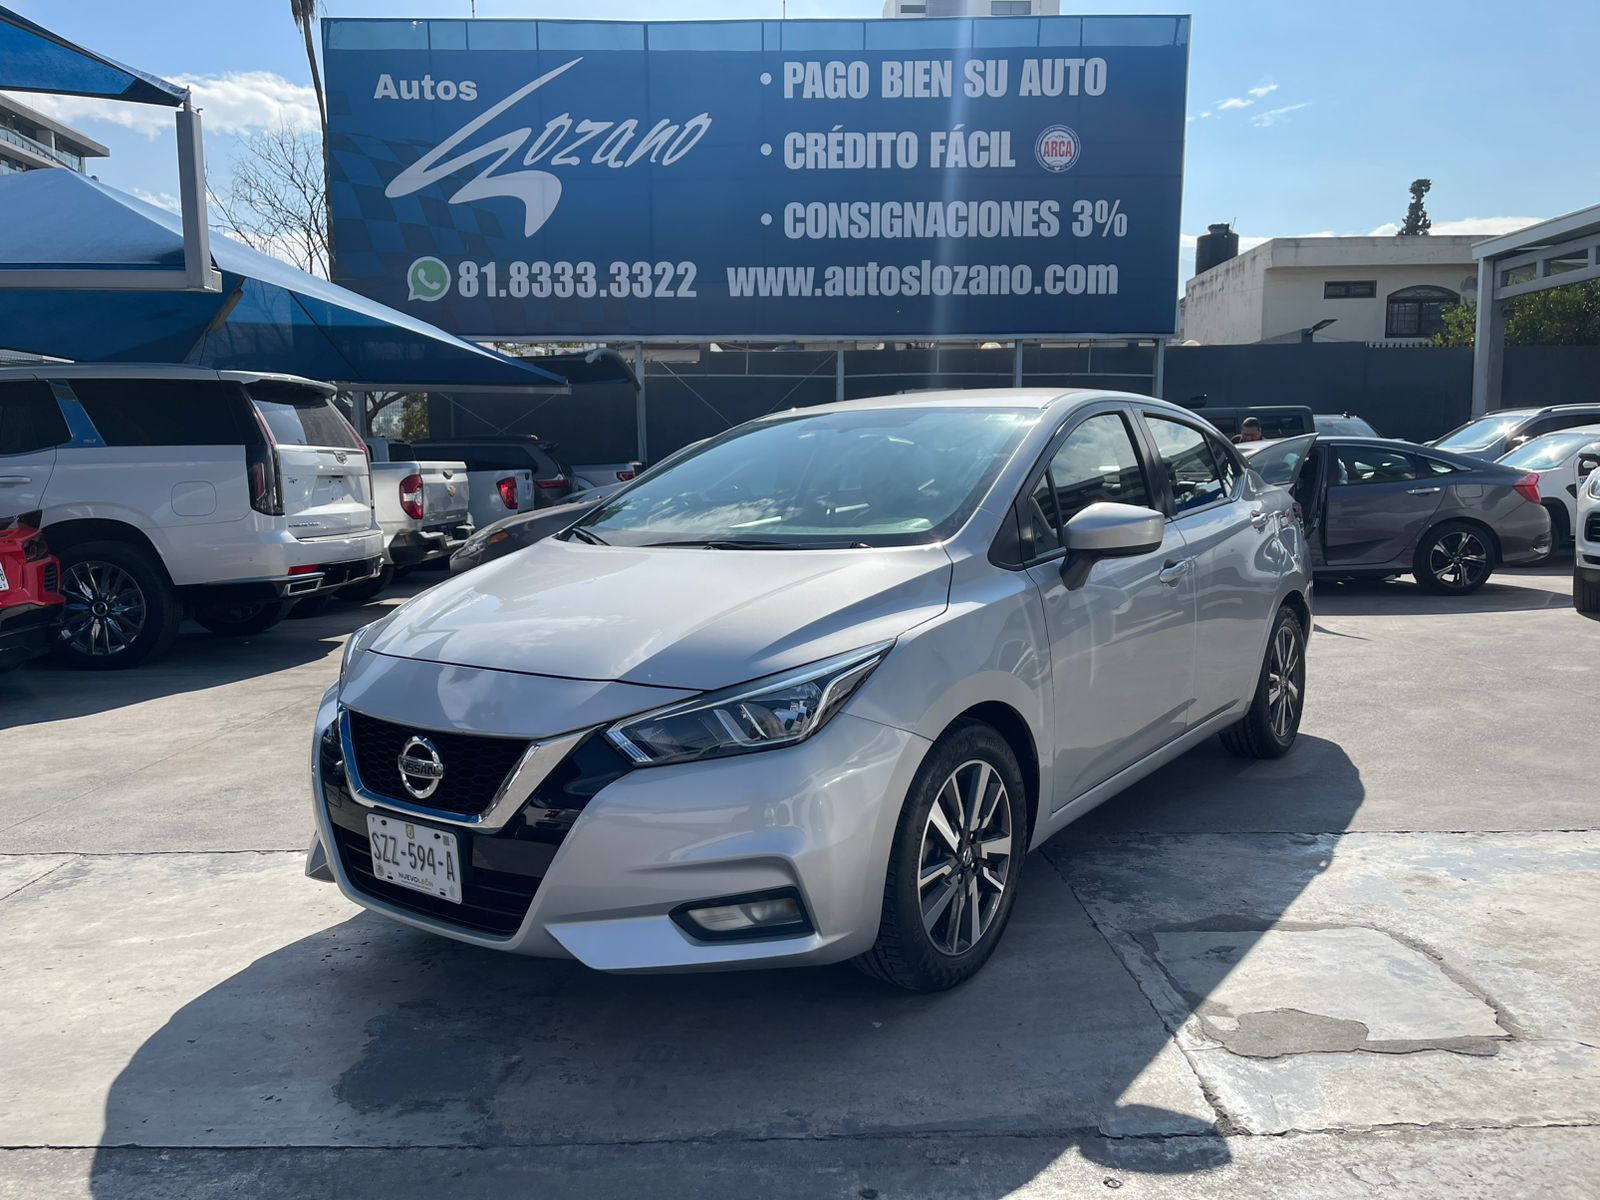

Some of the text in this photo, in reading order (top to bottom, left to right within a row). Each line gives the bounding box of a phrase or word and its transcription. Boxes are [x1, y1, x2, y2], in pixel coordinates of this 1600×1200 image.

[373, 74, 478, 102] Autos
[783, 57, 1108, 99] PAGO BIEN SU AUTO
[384, 56, 712, 238] Lozano
[783, 123, 1016, 169] CRÉDITO FÁCIL
[1043, 140, 1073, 158] ARCA
[783, 199, 1128, 239] CONSIGNACIONES 3%
[457, 261, 698, 298] 81.8333.3322
[726, 260, 1119, 297] www.autoslozano.com
[371, 832, 456, 882] SZZ-594-A
